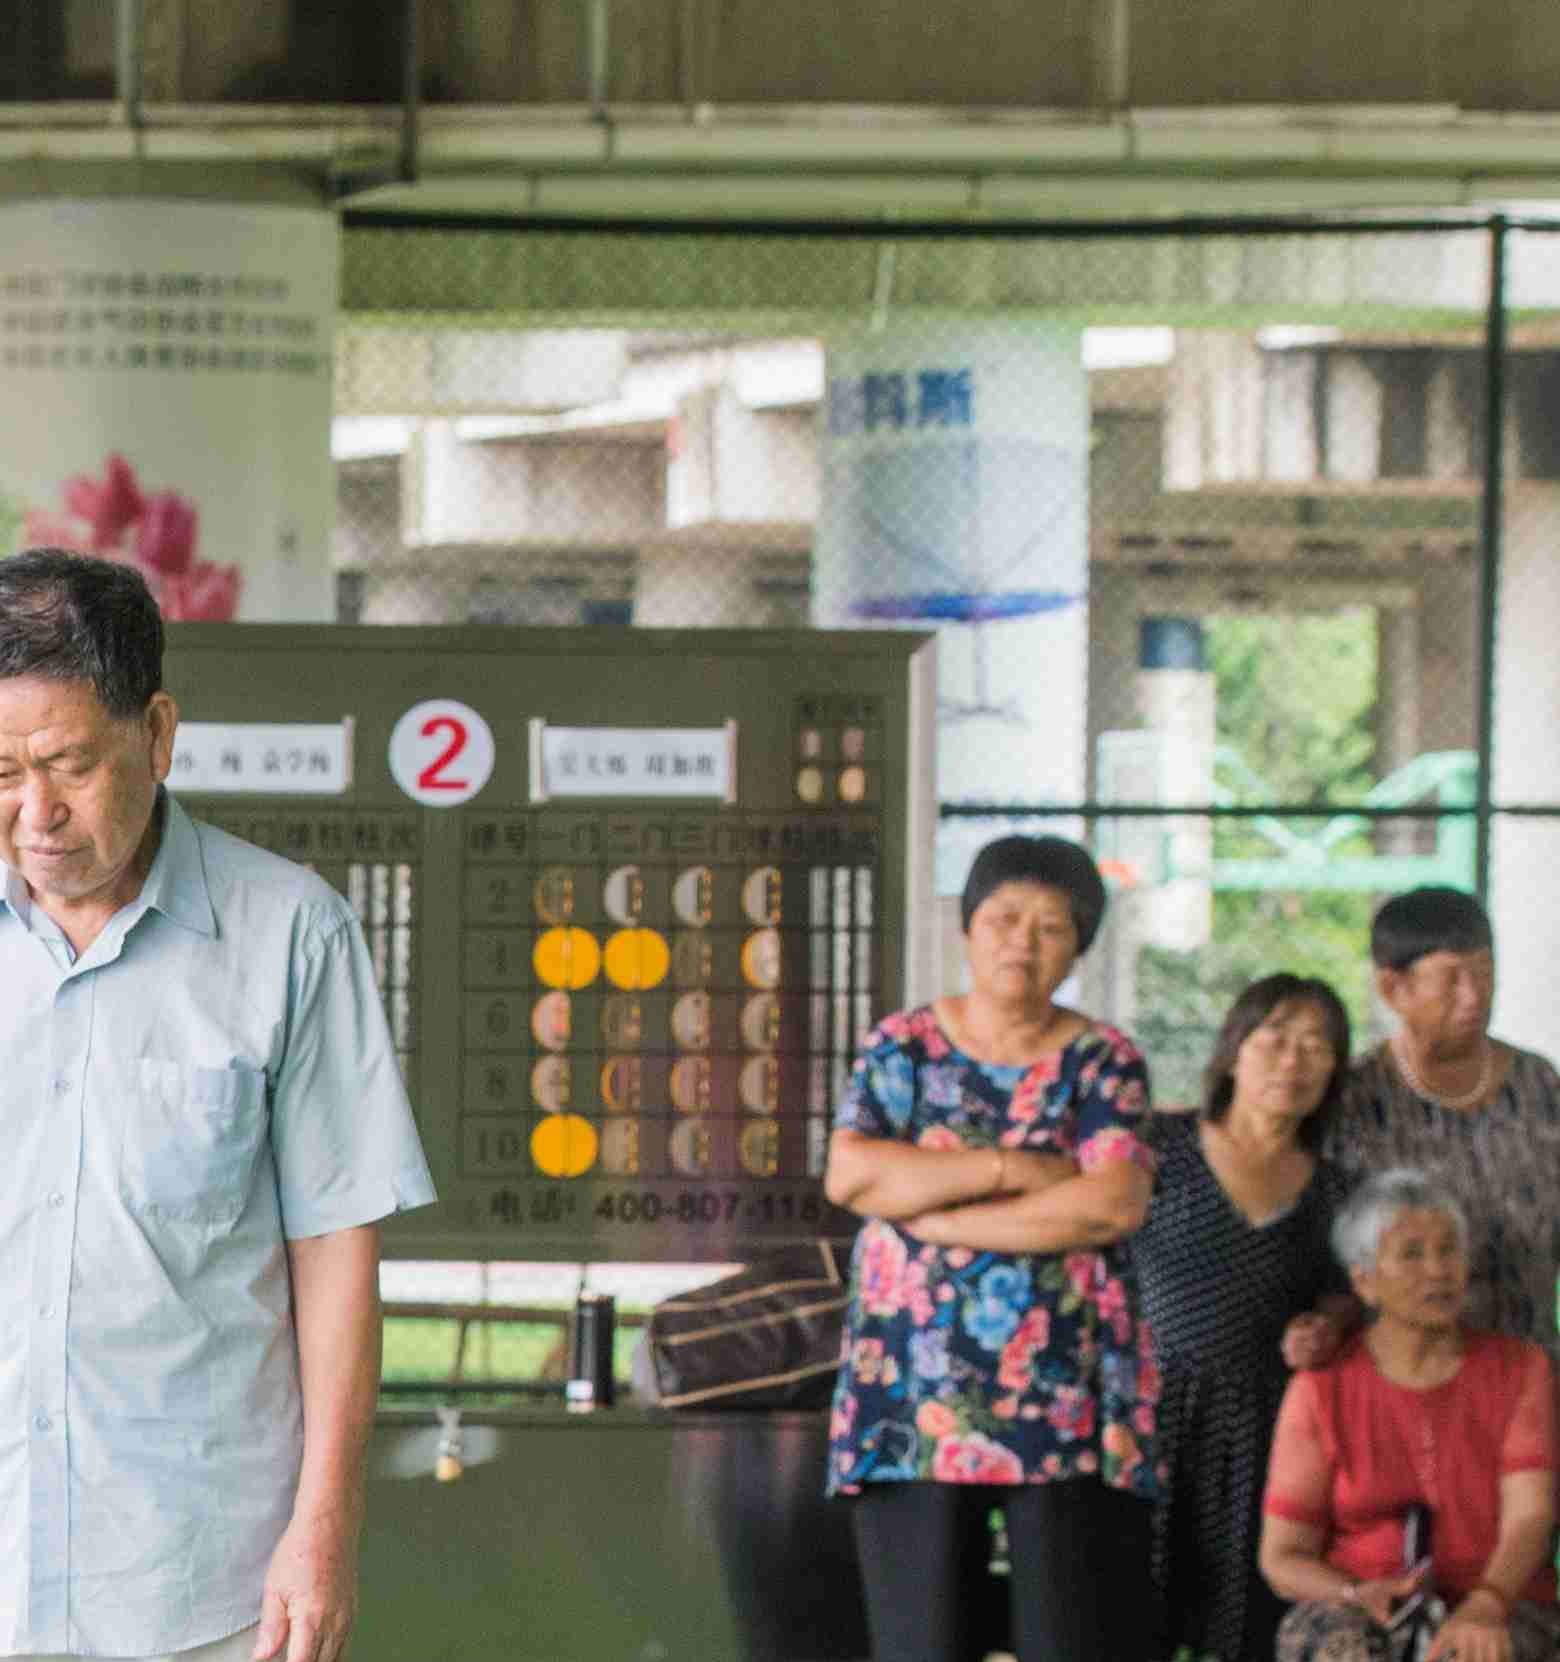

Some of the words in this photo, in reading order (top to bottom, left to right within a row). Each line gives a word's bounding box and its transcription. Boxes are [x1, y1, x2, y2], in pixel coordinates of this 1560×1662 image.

[418, 715, 469, 790] 2
[538, 823, 601, 856] 一门
[610, 823, 671, 856] 二门
[475, 1127, 521, 1165] 10
[595, 1190, 838, 1223] 400-807-118
